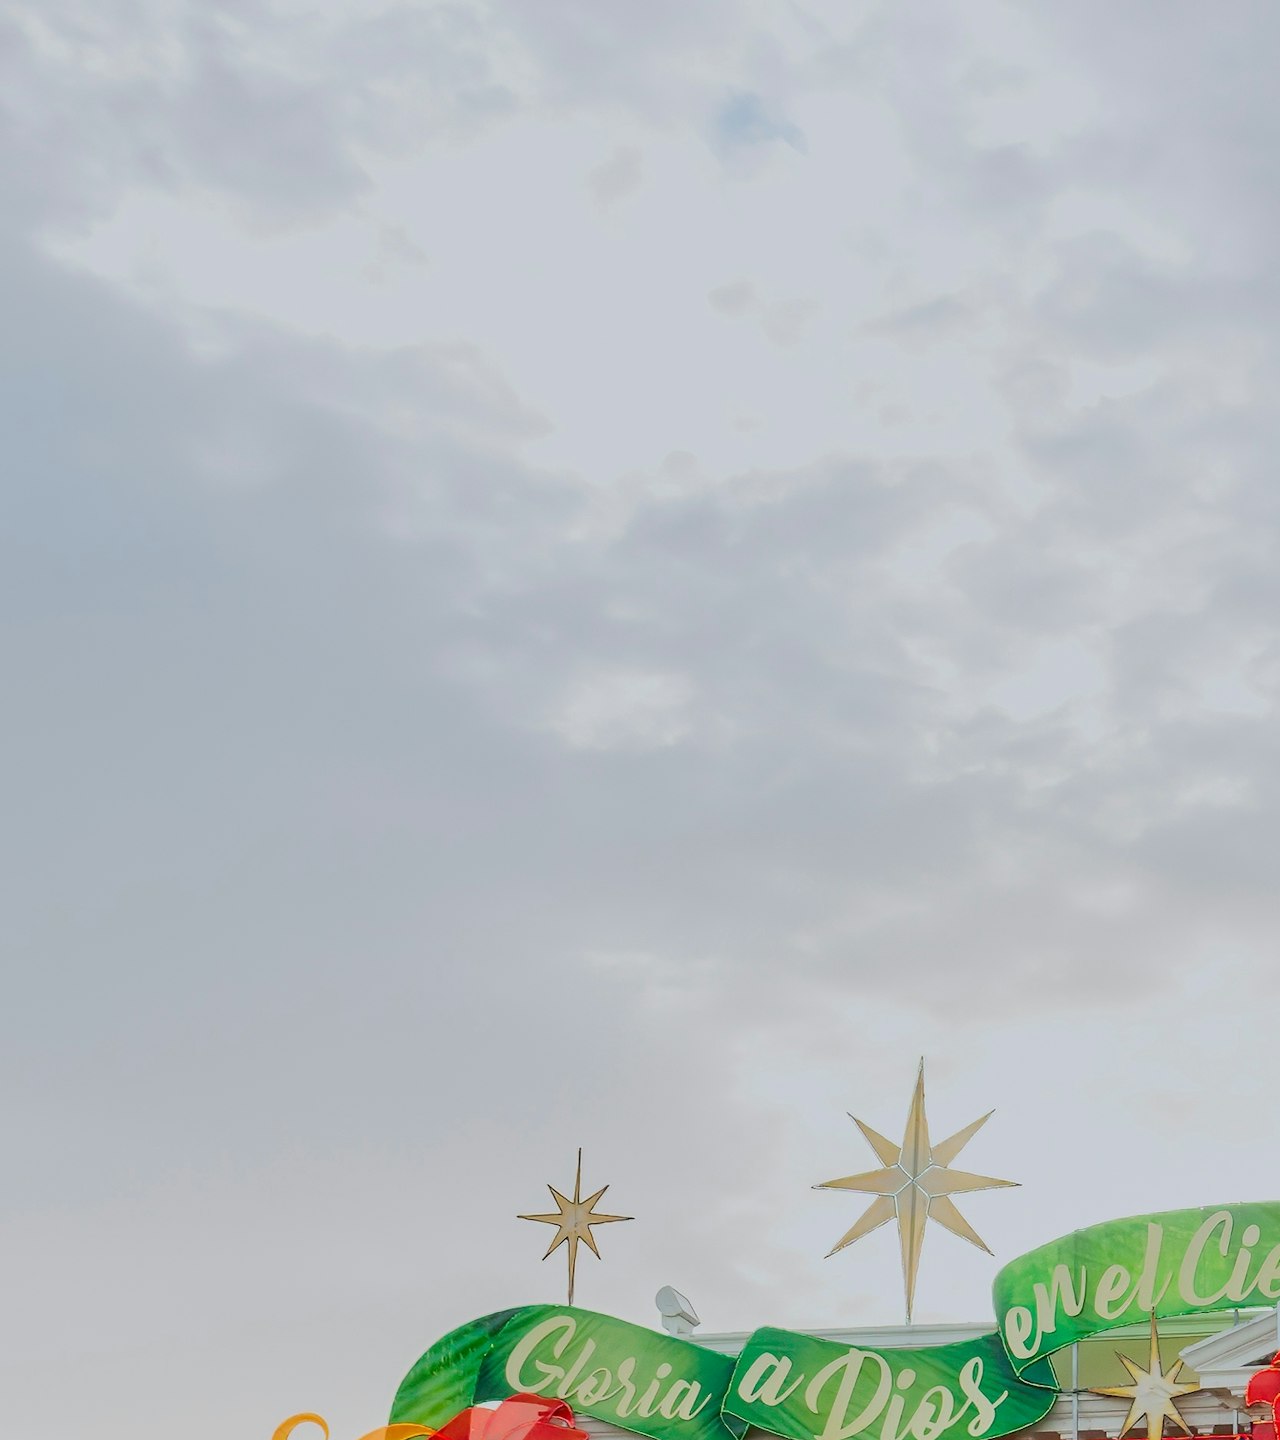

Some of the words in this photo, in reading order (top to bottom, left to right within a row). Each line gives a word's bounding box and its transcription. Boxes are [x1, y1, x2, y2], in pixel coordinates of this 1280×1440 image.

[504, 1315, 714, 1422] Gloria
[737, 1351, 804, 1406] a
[1004, 1263, 1088, 1359] en
[1099, 1222, 1178, 1319] el
